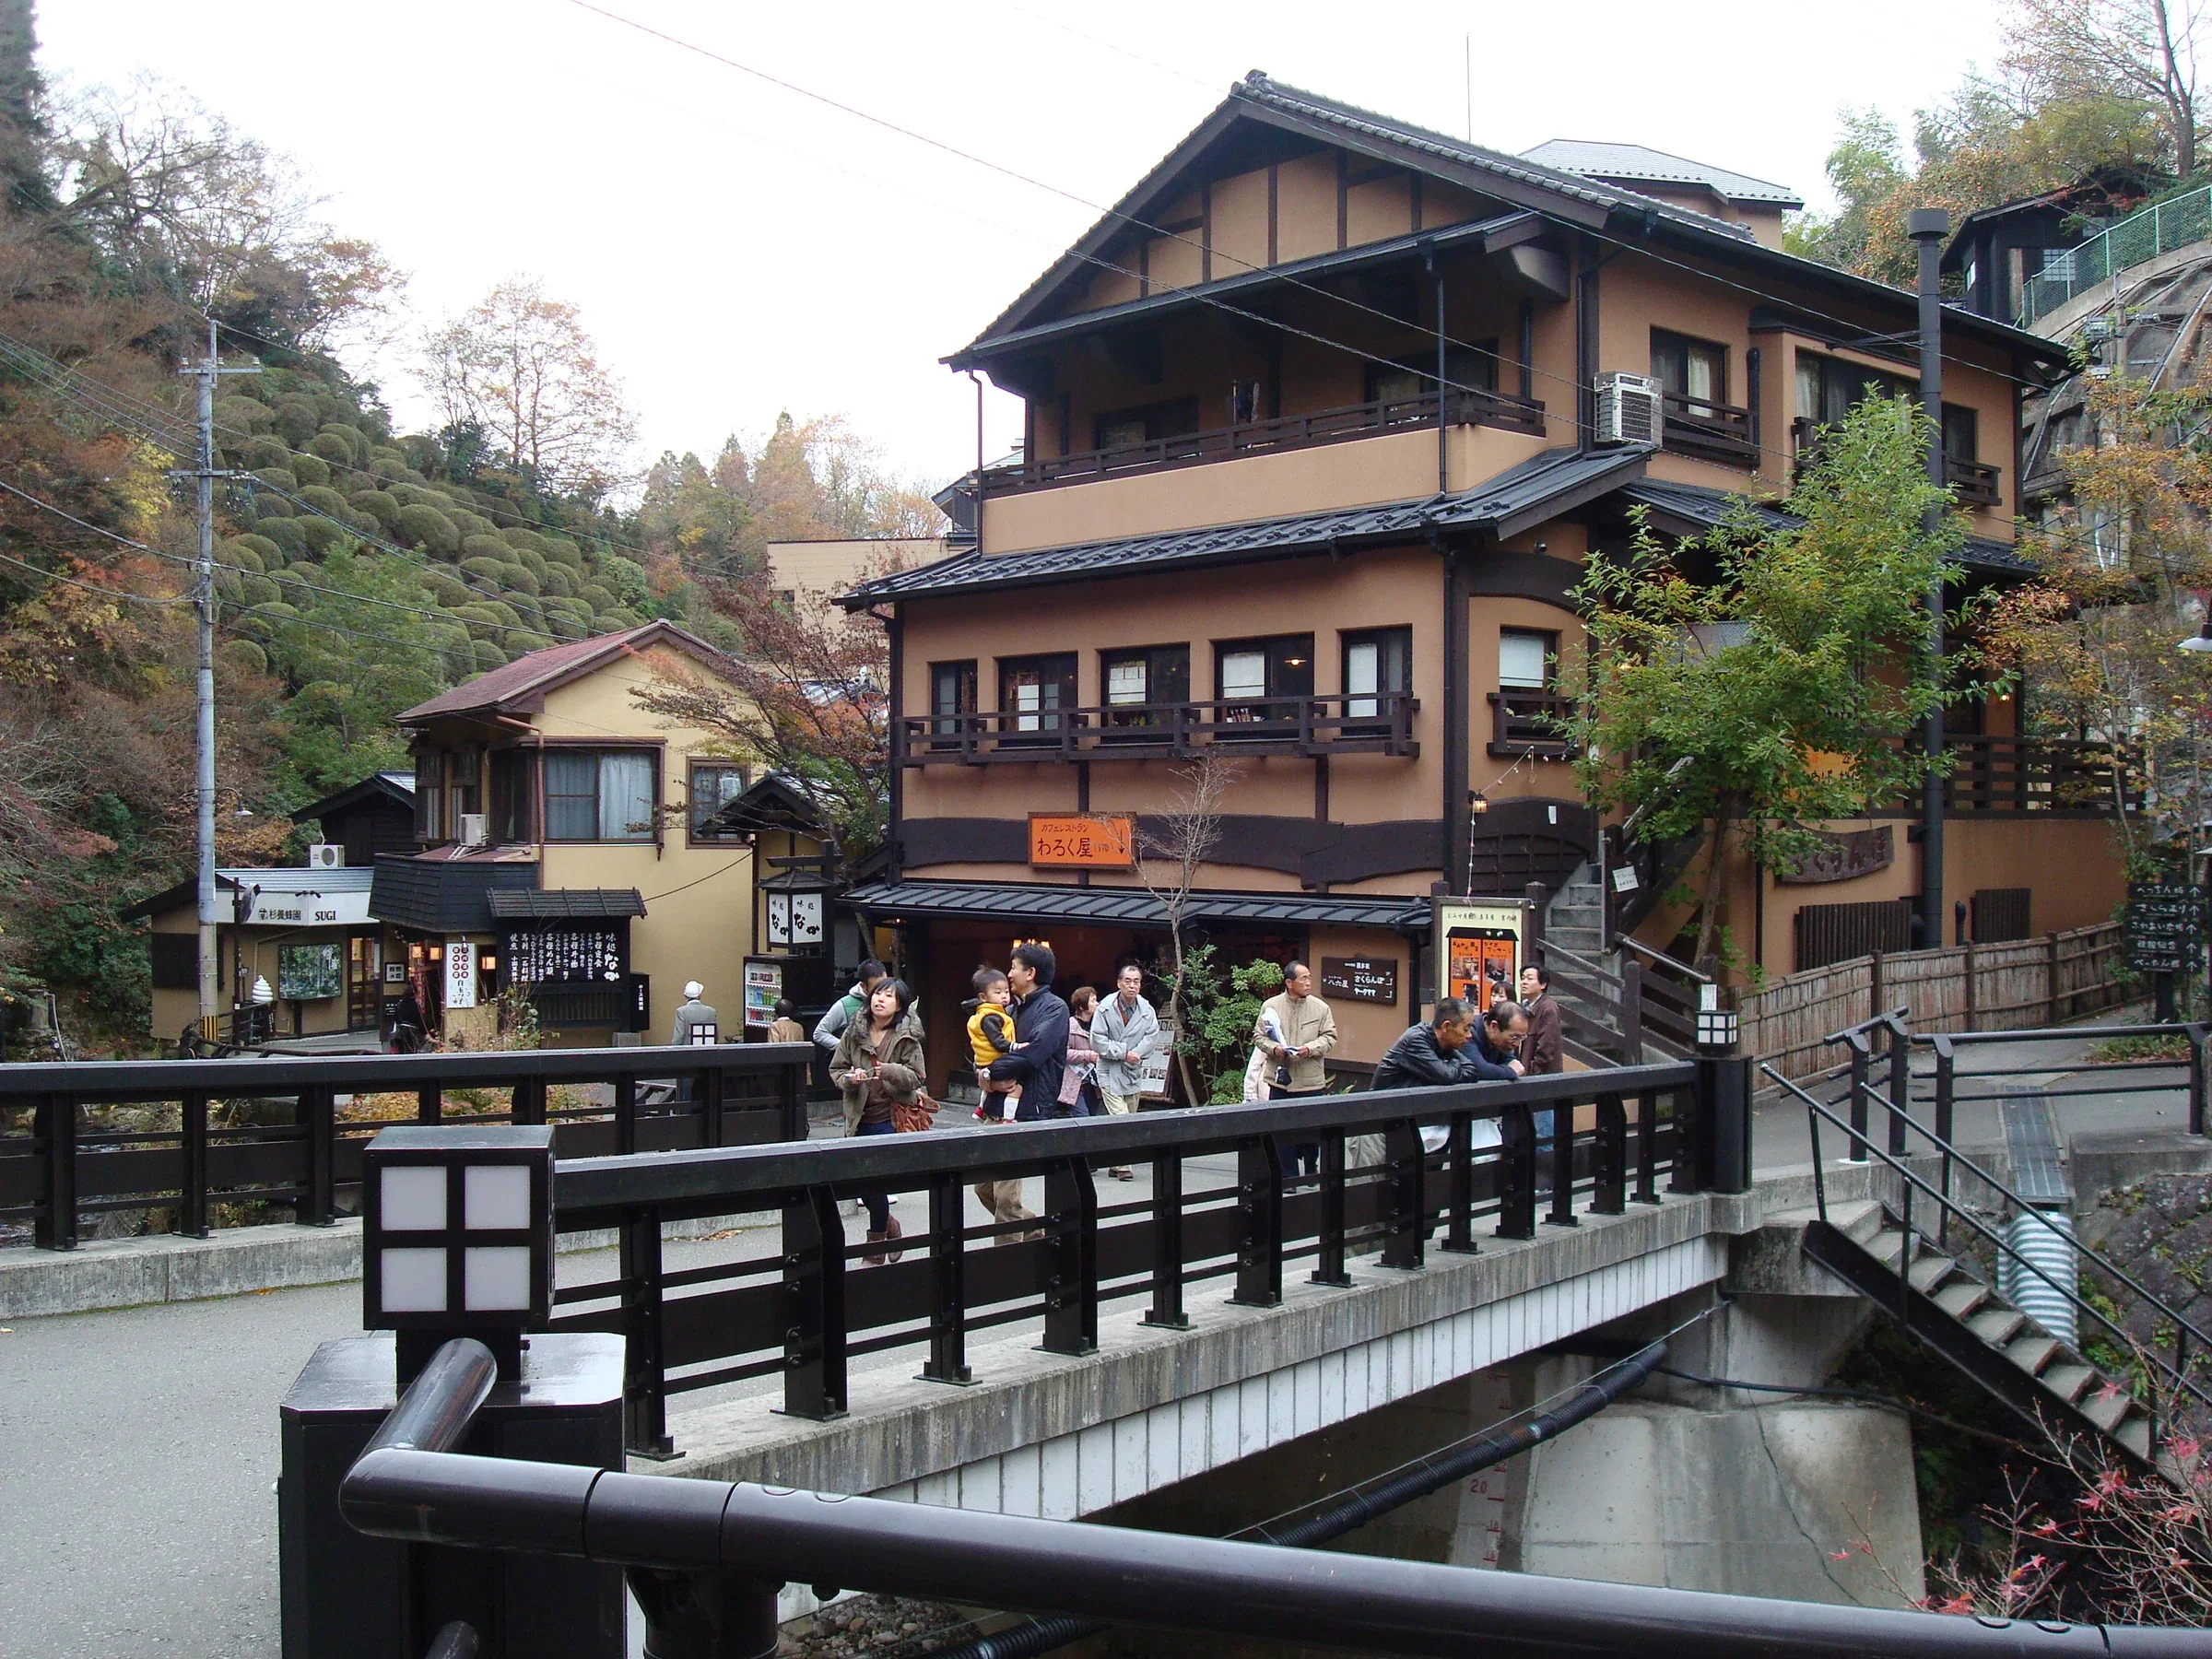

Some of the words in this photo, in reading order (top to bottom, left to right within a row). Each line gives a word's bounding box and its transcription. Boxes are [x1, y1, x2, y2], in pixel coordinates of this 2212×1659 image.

[1041, 823, 1088, 833] カフェレストラン
[1038, 838, 1093, 857] わろく屋
[314, 911, 336, 921] SUGI
[794, 912, 820, 935] なか
[1471, 1478, 1488, 1494] 20
